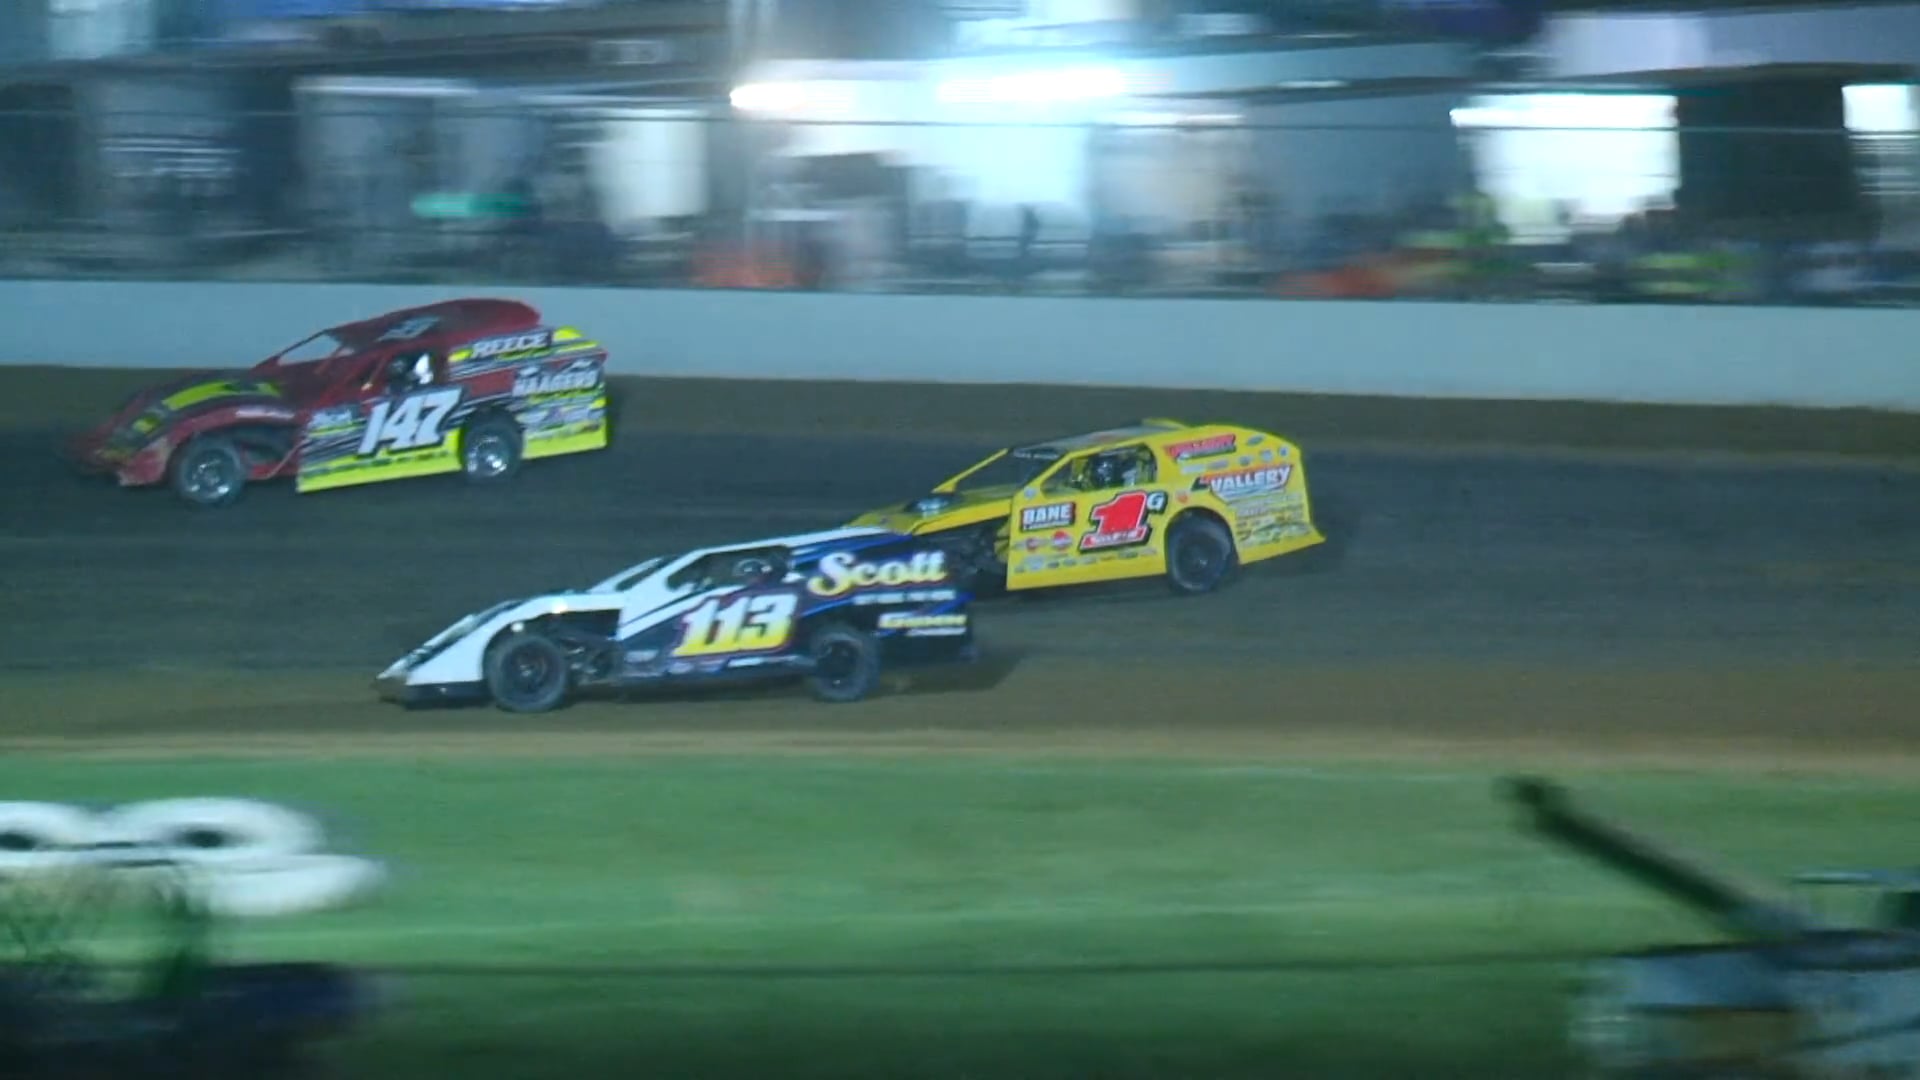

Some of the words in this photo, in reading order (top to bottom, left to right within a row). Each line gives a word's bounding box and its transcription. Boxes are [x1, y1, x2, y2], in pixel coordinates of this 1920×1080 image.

[471, 331, 548, 359] REECE
[357, 387, 463, 455] 147
[1210, 466, 1292, 492] VALLERY
[1022, 502, 1073, 526] BANE
[806, 550, 947, 597] Scott
[672, 593, 799, 657] 113
